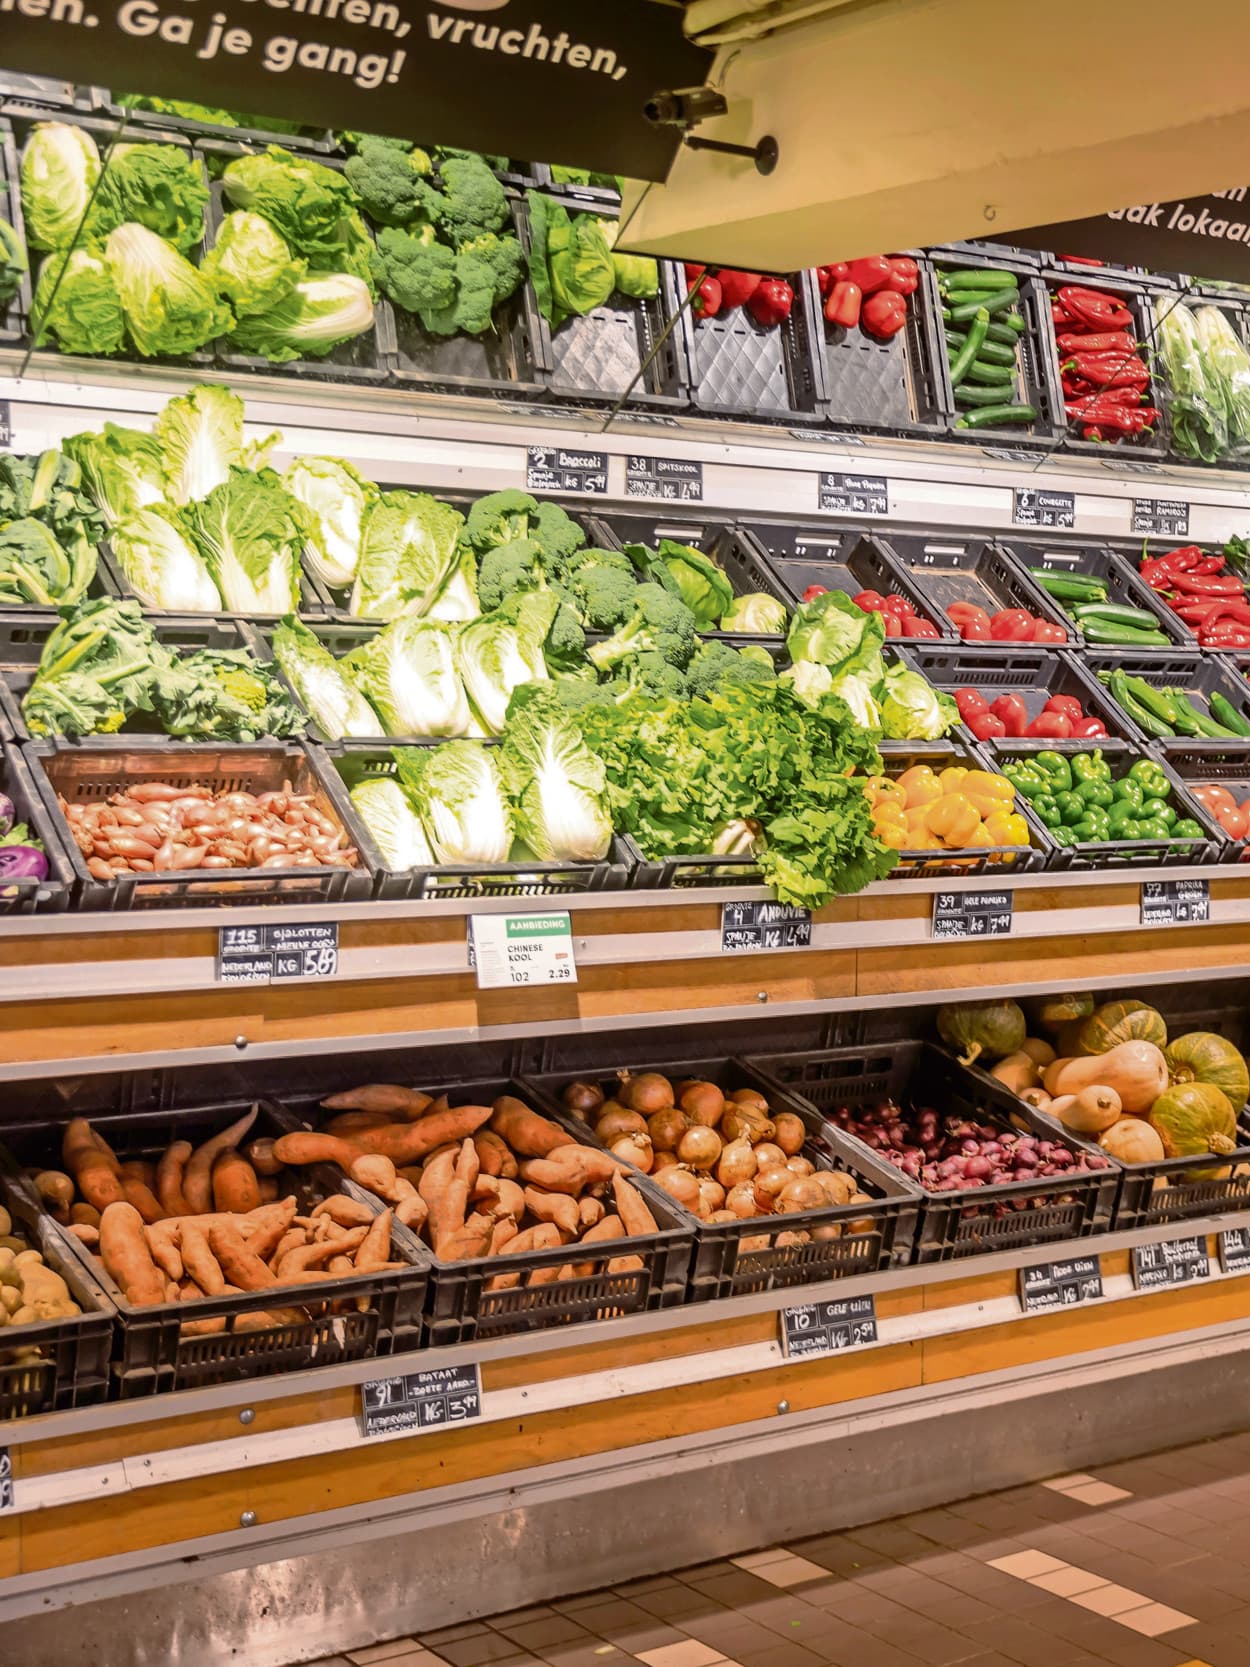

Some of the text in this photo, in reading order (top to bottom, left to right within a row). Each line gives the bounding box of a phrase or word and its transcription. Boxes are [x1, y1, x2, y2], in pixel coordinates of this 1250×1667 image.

[0, 0, 407, 88] en. Ga je gang!
[426, 13, 628, 81] vruchten,
[533, 451, 549, 469] 2
[631, 457, 698, 473] 38 SPITSKOOL
[939, 895, 955, 908] 39
[510, 920, 566, 930] AANBIEDING
[227, 929, 257, 944] 115
[507, 944, 544, 953] CHINESE
[508, 954, 533, 962] KOOL
[511, 972, 529, 982] 102
[794, 1315, 810, 1330] 10
[418, 1367, 459, 1383] BATAAT
